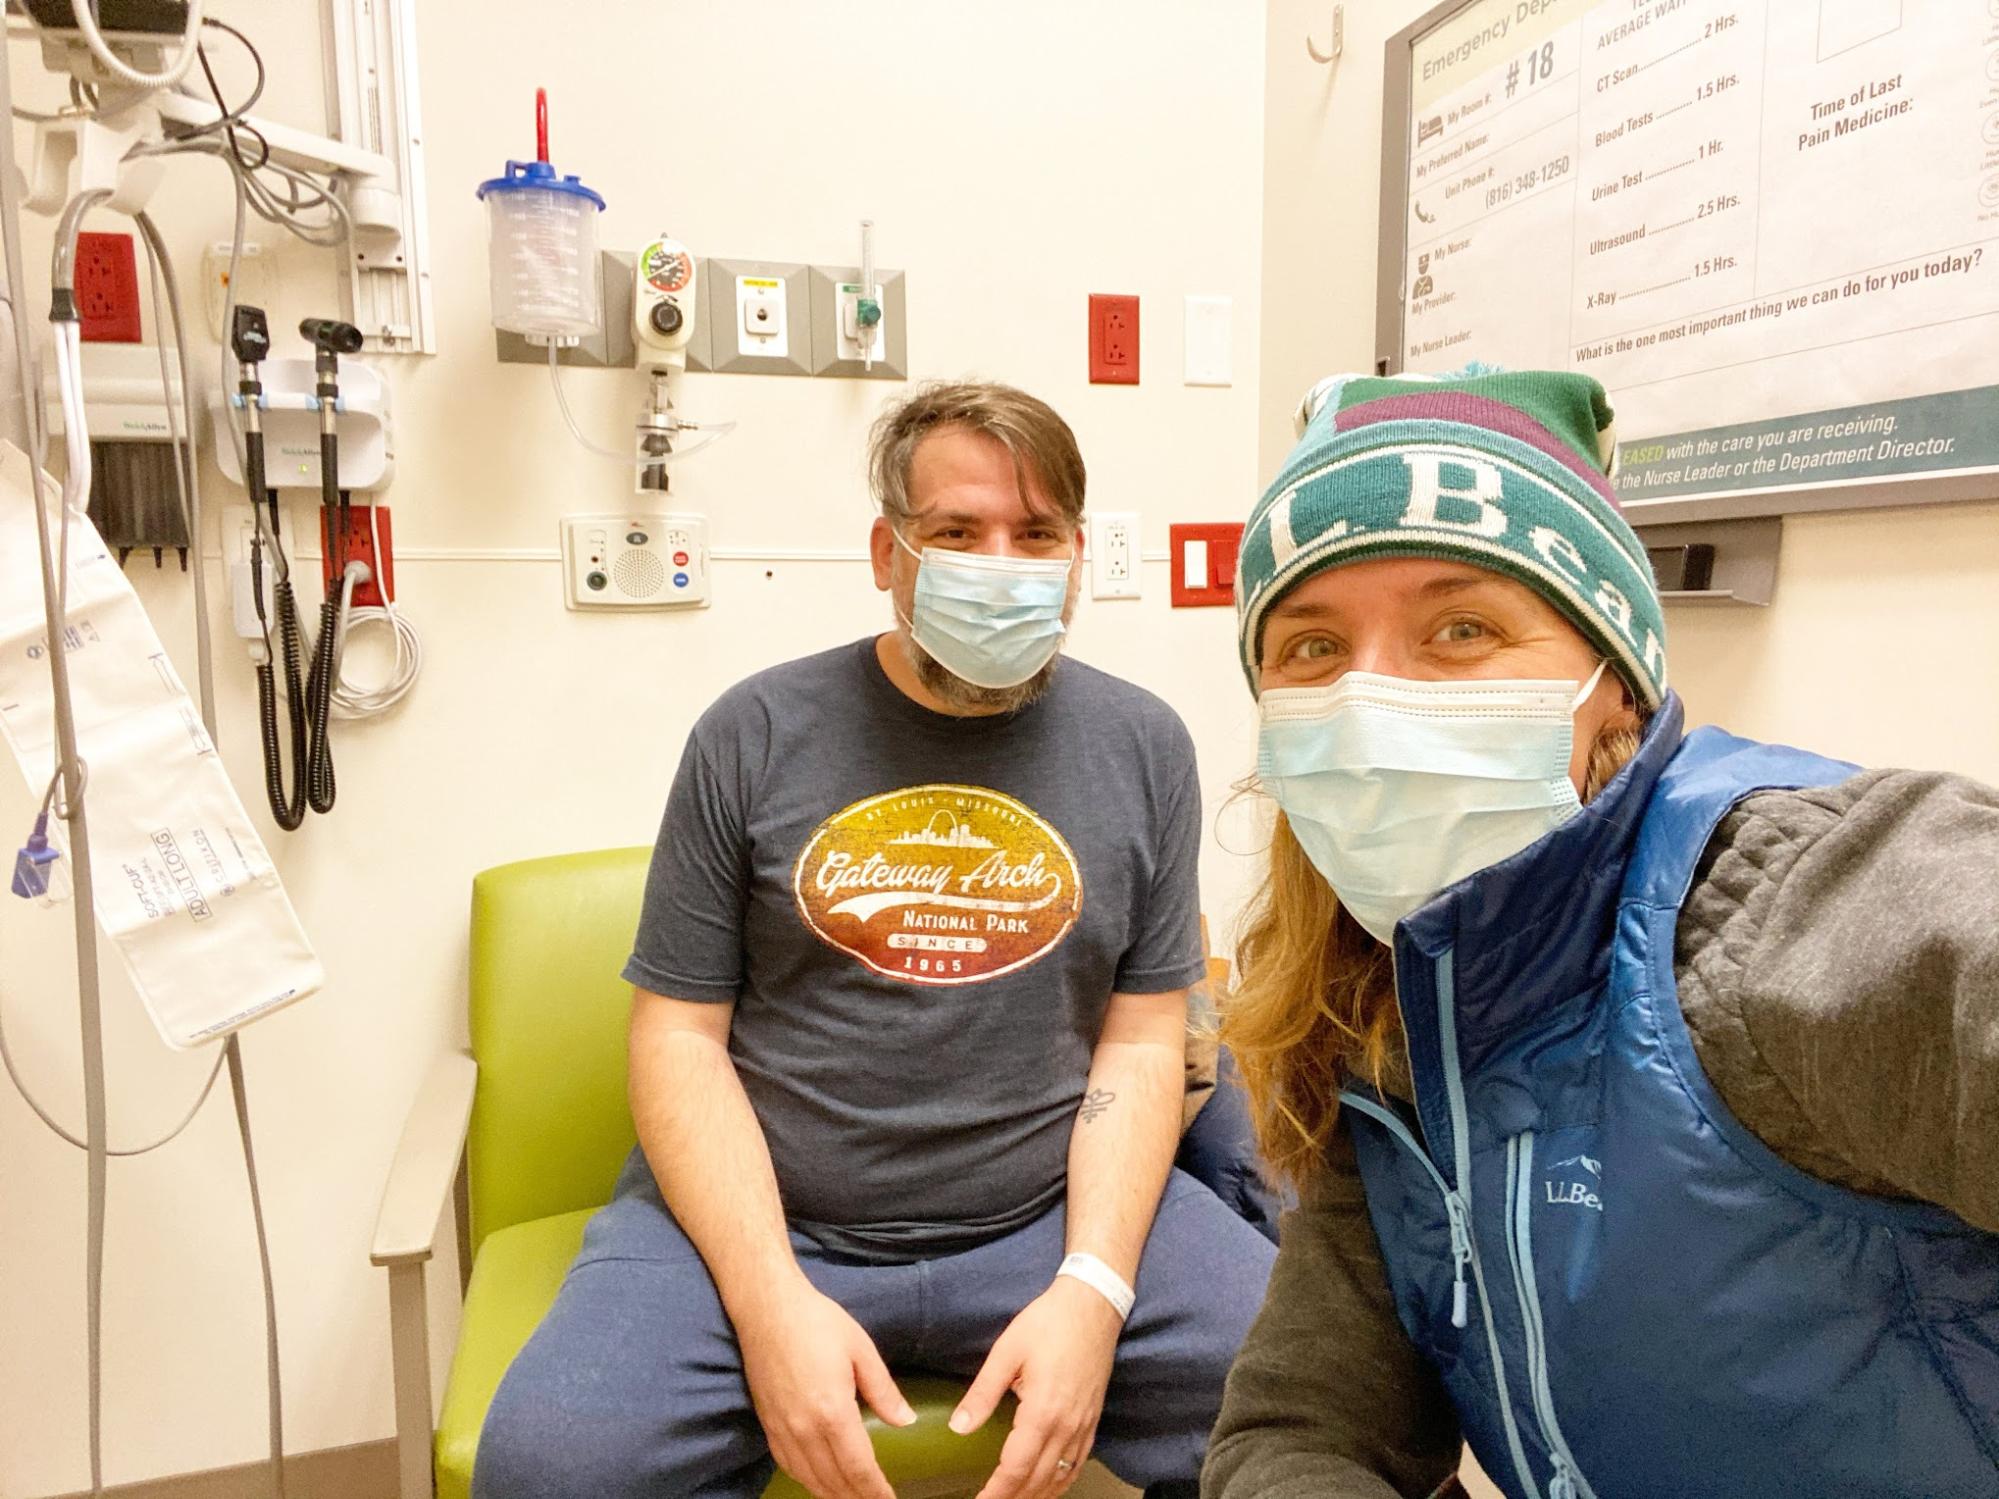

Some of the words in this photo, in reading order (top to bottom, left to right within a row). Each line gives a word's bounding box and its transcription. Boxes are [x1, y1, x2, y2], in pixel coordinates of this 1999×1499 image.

[1423, 16, 1510, 81] Emergency
[1516, 0, 1559, 24] Dep
[1597, 10, 1651, 50] AVERAGE
[1704, 23, 1713, 39] 2
[1715, 14, 1739, 33] Hrs.
[1506, 60, 1520, 98] #
[1528, 41, 1554, 85] 18
[1597, 74, 1610, 93] CT
[1697, 82, 1713, 101] 1.5
[1716, 74, 1740, 94] Hrs.
[1811, 99, 1845, 121] Time
[1851, 86, 1865, 105] of
[1870, 74, 1903, 98] Last
[1447, 110, 1459, 126] My
[1461, 99, 1483, 117] Room
[1798, 129, 1830, 151] Pain
[1834, 98, 1914, 138] Medicine:
[1595, 126, 1624, 147] Blood
[1627, 112, 1653, 132] Tests
[1416, 165, 1427, 178] My
[1429, 144, 1463, 172] Preferred
[1464, 134, 1489, 152] Name:
[1699, 145, 1705, 160] 1
[1708, 139, 1723, 154] Hr.
[1445, 182, 1460, 199] Unit
[1462, 173, 1486, 190] Phone
[1485, 180, 1513, 208] (816)
[1515, 155, 1570, 194] 348-1250
[1592, 181, 1618, 202] Urine
[1622, 171, 1643, 190] Test
[1697, 200, 1713, 219] 2.5
[1717, 194, 1741, 213] Hrs.
[1434, 247, 1446, 261] My
[1447, 238, 1472, 254] Nurse:
[1590, 224, 1646, 256] Ultrasound
[1694, 260, 1710, 278] 1.5
[1713, 256, 1738, 273] Hrs.
[1412, 302, 1423, 315] My
[1424, 291, 1456, 311] Provider:
[1576, 346, 1602, 362] What
[1605, 343, 1613, 356] is
[1616, 339, 1632, 353] the
[1636, 334, 1656, 348] one
[1658, 325, 1686, 343] most
[1689, 309, 1747, 336] important
[1750, 302, 1782, 321] thing
[1787, 296, 1807, 311] we
[1812, 288, 1838, 305] can
[1843, 280, 1861, 298] do
[1866, 276, 1887, 292] for
[1891, 268, 1919, 290] you
[1924, 248, 1983, 278] today?
[1587, 292, 1617, 309] X-Ray
[1410, 344, 1421, 357] My
[1422, 337, 1443, 353] Nurse
[1445, 330, 1472, 346] Leader:
[1622, 445, 1664, 466] EASED
[1667, 441, 1693, 460] with
[1697, 439, 1717, 455] the
[1722, 436, 1753, 452] care
[1758, 430, 1783, 452] you
[1788, 427, 1813, 443] are
[1817, 414, 1898, 439] receiving.
[1623, 474, 1640, 489] the
[1644, 469, 1681, 486] Nurse
[1684, 462, 1733, 482] Leader
[1734, 461, 1750, 476] or
[1752, 456, 1776, 474] the
[1780, 445, 1875, 472] Department
[1877, 437, 1955, 460] Director.
[155, 832, 185, 873] LONG
[816, 850, 954, 898] Gateway
[959, 849, 1048, 893] Arch
[175, 875, 207, 918] ADULT
[903, 910, 978, 932] NATIONAL
[986, 915, 1030, 934] PARK
[897, 937, 975, 950] SINCE
[904, 957, 961, 972] 1965
